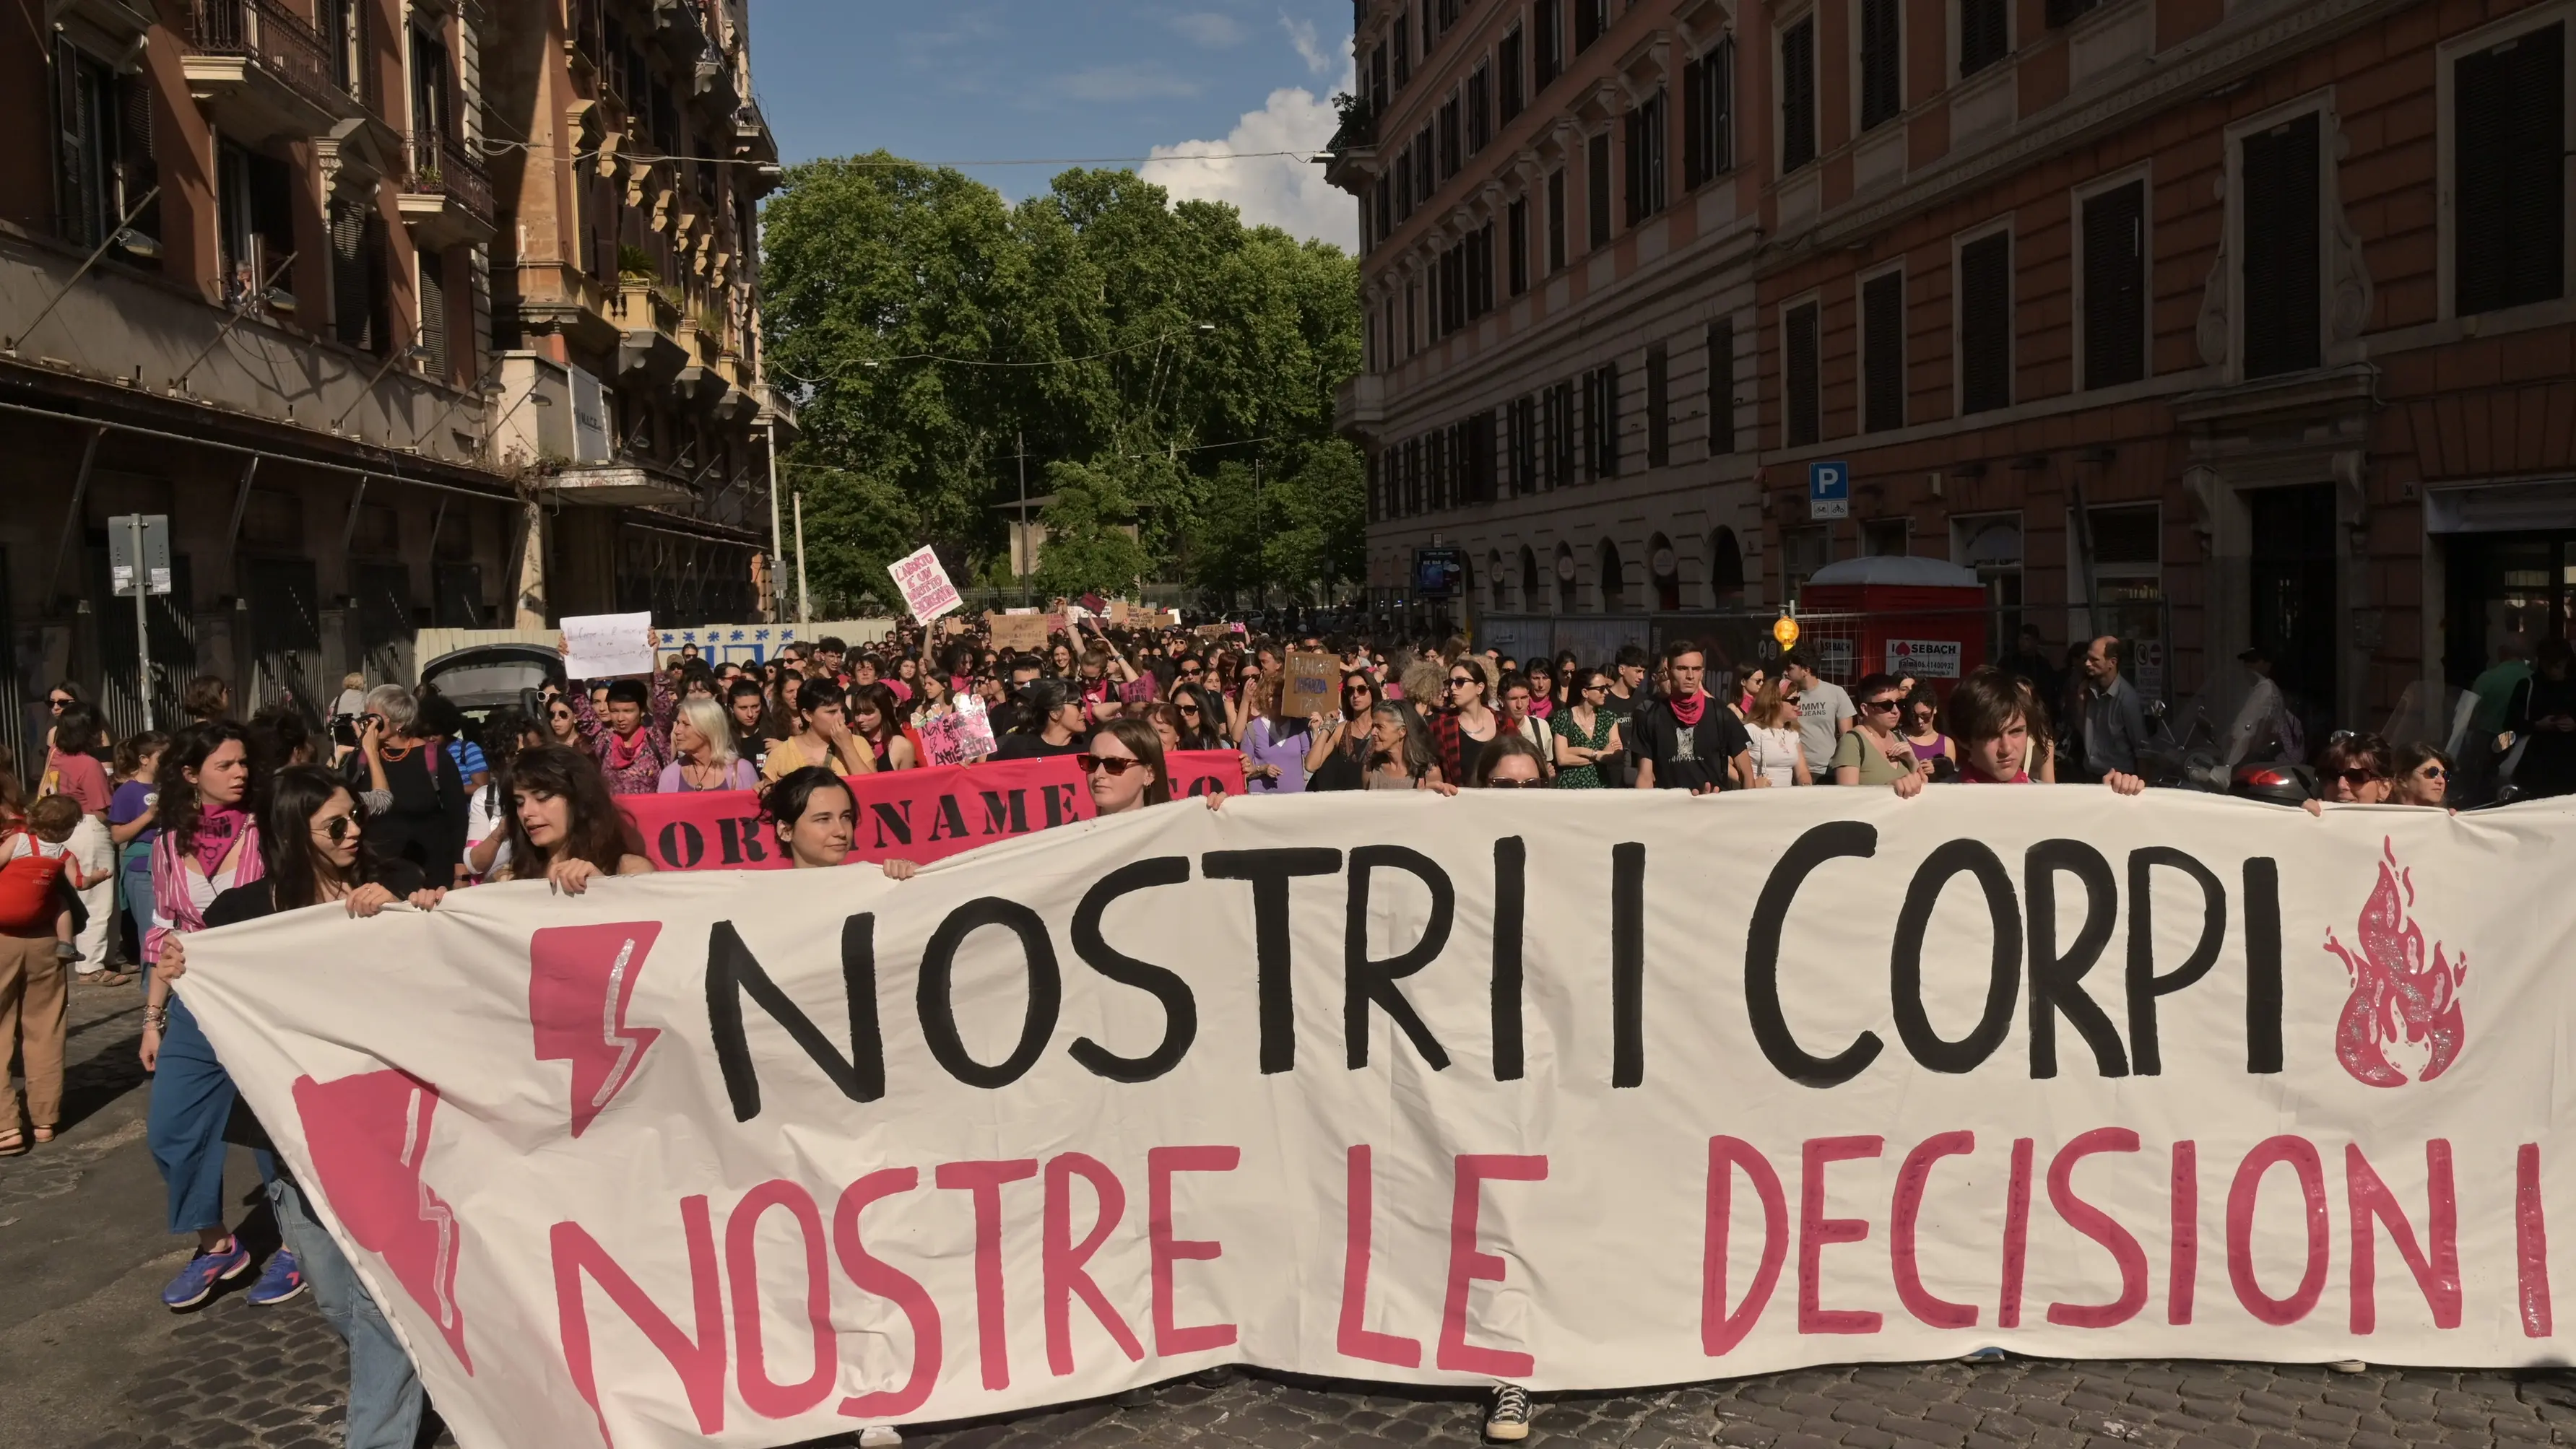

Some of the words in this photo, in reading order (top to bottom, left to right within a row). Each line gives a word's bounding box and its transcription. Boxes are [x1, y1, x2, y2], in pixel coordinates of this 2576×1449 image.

[1818, 468, 1839, 495] P
[895, 553, 934, 582] L'ABORTO
[917, 567, 932, 581] UN
[906, 575, 942, 602] DIRITTO
[1912, 644, 1956, 654] SEBACH
[922, 722, 941, 739] NON
[704, 835, 1525, 1123] NOSTRI
[1612, 841, 1645, 1088] I
[1745, 821, 2284, 1089] CORPI
[550, 1145, 1240, 1449] NOSTRE
[1337, 1144, 1548, 1377] LE
[1701, 1126, 2553, 1357] DECISIONI
